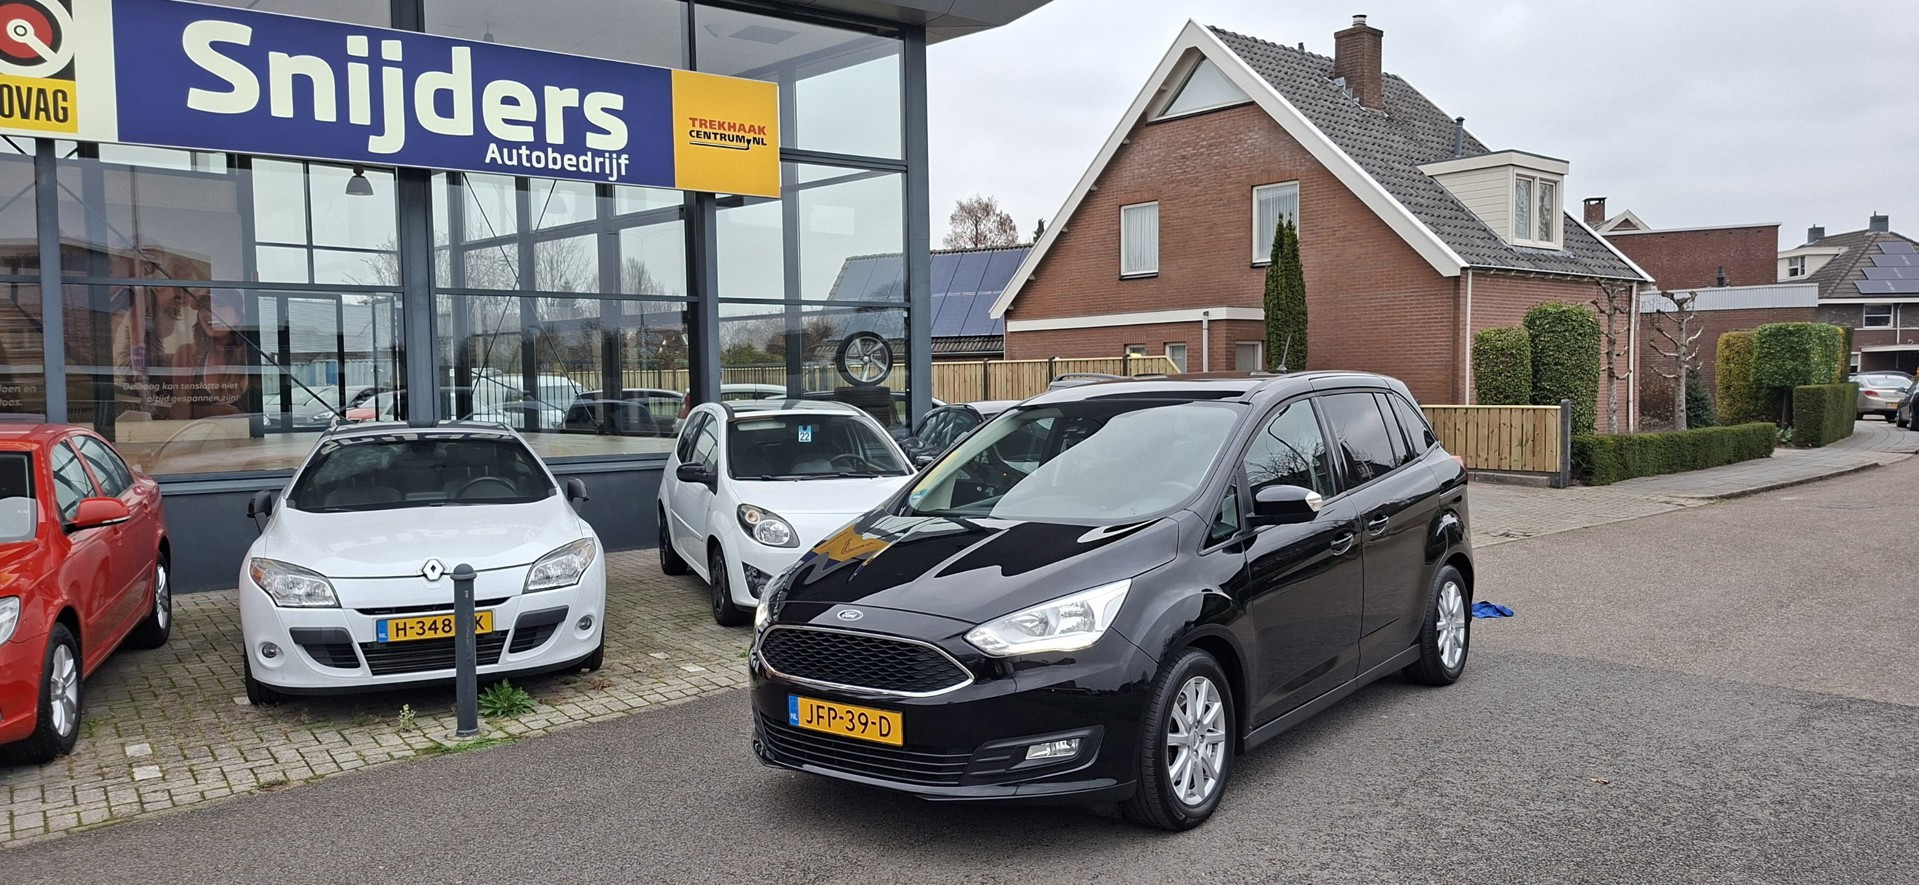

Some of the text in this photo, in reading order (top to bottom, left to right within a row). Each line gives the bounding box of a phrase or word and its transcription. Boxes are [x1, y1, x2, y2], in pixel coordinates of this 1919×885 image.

[0, 83, 69, 124] OVAG
[181, 19, 629, 154] Snijders
[688, 117, 767, 136] TREKHAAK
[485, 142, 630, 181] Autobedrijf
[800, 432, 810, 441] 22
[395, 614, 485, 638] H-348K
[789, 703, 892, 738] NL JFP-39-D
